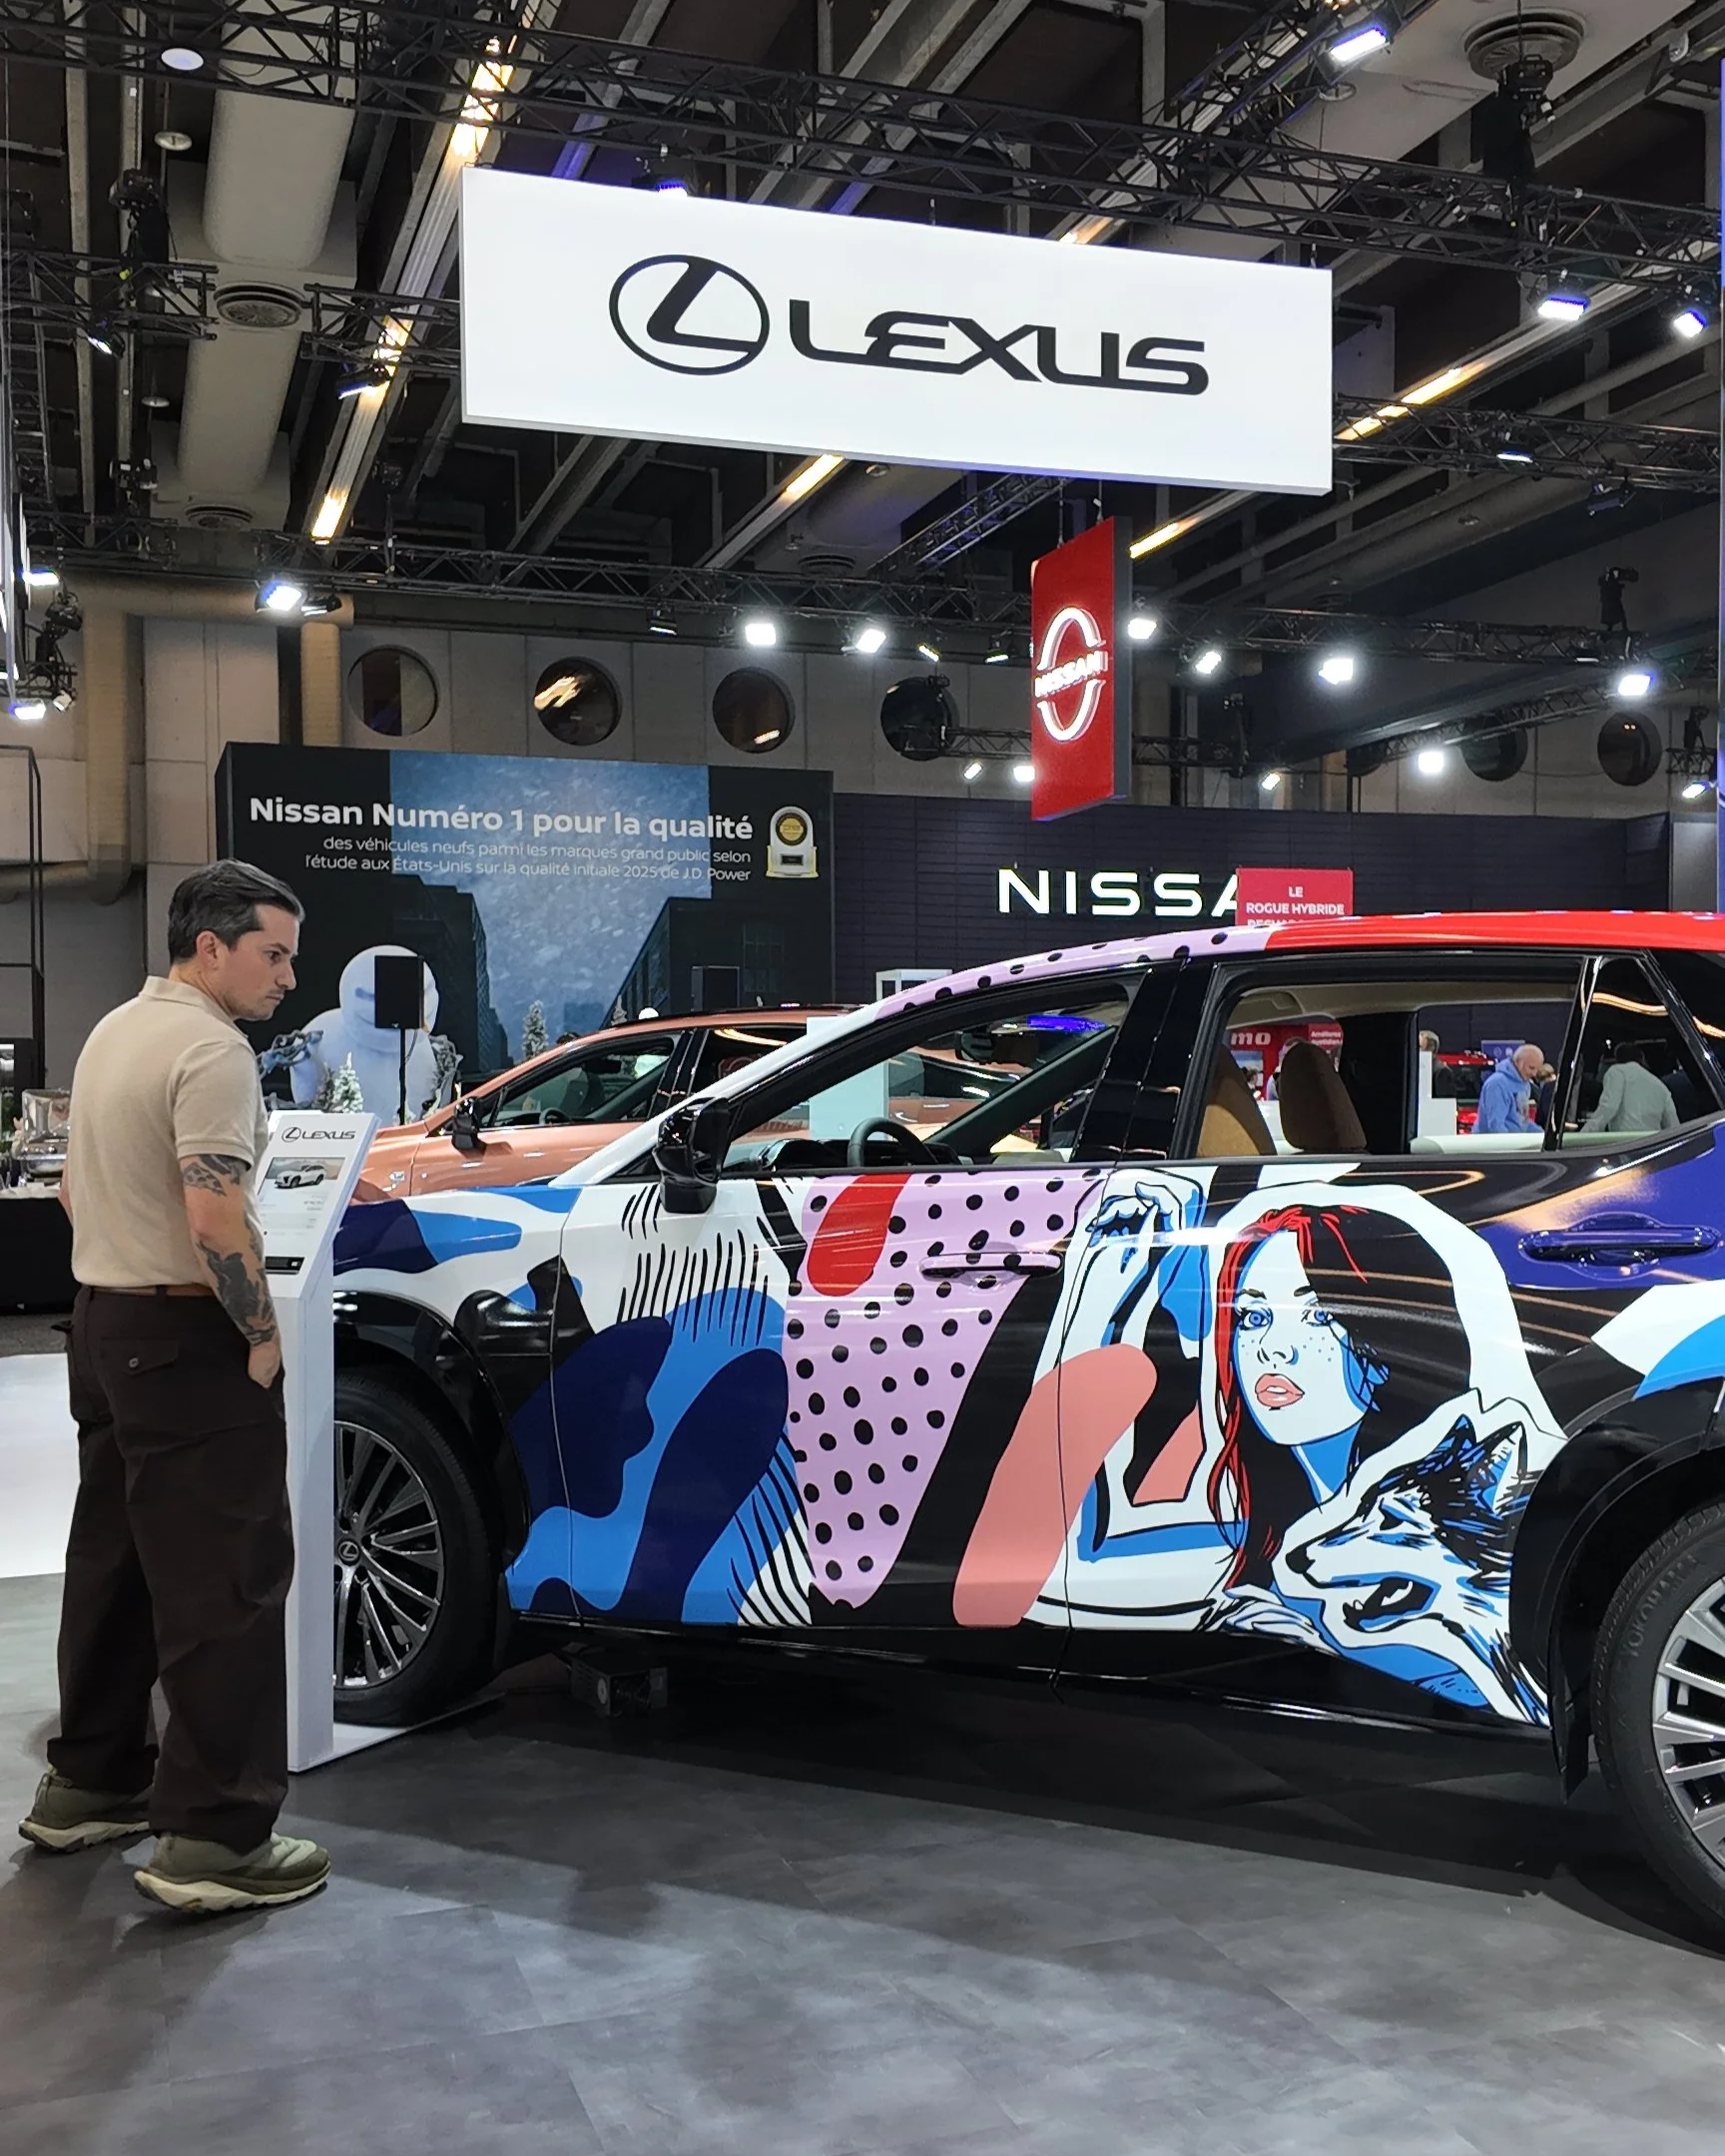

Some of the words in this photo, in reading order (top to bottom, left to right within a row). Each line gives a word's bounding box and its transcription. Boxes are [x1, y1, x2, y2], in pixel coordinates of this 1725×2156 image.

[790, 298, 1210, 396] LEXUS
[1035, 650, 1108, 698] NISSAN
[250, 797, 363, 826] Nissan
[372, 803, 503, 831] Numéro
[510, 808, 524, 831] 1
[533, 812, 607, 836] pour
[614, 810, 642, 835] la
[650, 813, 754, 841] qualité
[322, 836, 353, 850] des
[355, 836, 429, 854] véhicules
[431, 839, 475, 855] neufs
[478, 841, 524, 859] parmi
[526, 842, 548, 856] les
[550, 844, 617, 862] marques
[621, 846, 664, 863] grand
[667, 848, 710, 864] public
[713, 849, 752, 863] selon
[304, 854, 357, 870] l'étude
[360, 858, 390, 870] aux
[392, 856, 472, 873] États-Unis
[475, 861, 502, 874] sur
[503, 860, 516, 875] la
[519, 860, 570, 878] qualité
[573, 862, 620, 877] initiale
[622, 864, 658, 878] 2025
[660, 864, 680, 878] de
[707, 867, 752, 881] Power
[1288, 886, 1304, 897] LE
[1246, 902, 1290, 914] ROGUE
[1292, 903, 1345, 915] HYBRIDE
[301, 1130, 356, 1140] LEXUS
[1619, 1552, 1700, 1658] YOKOHAMA
